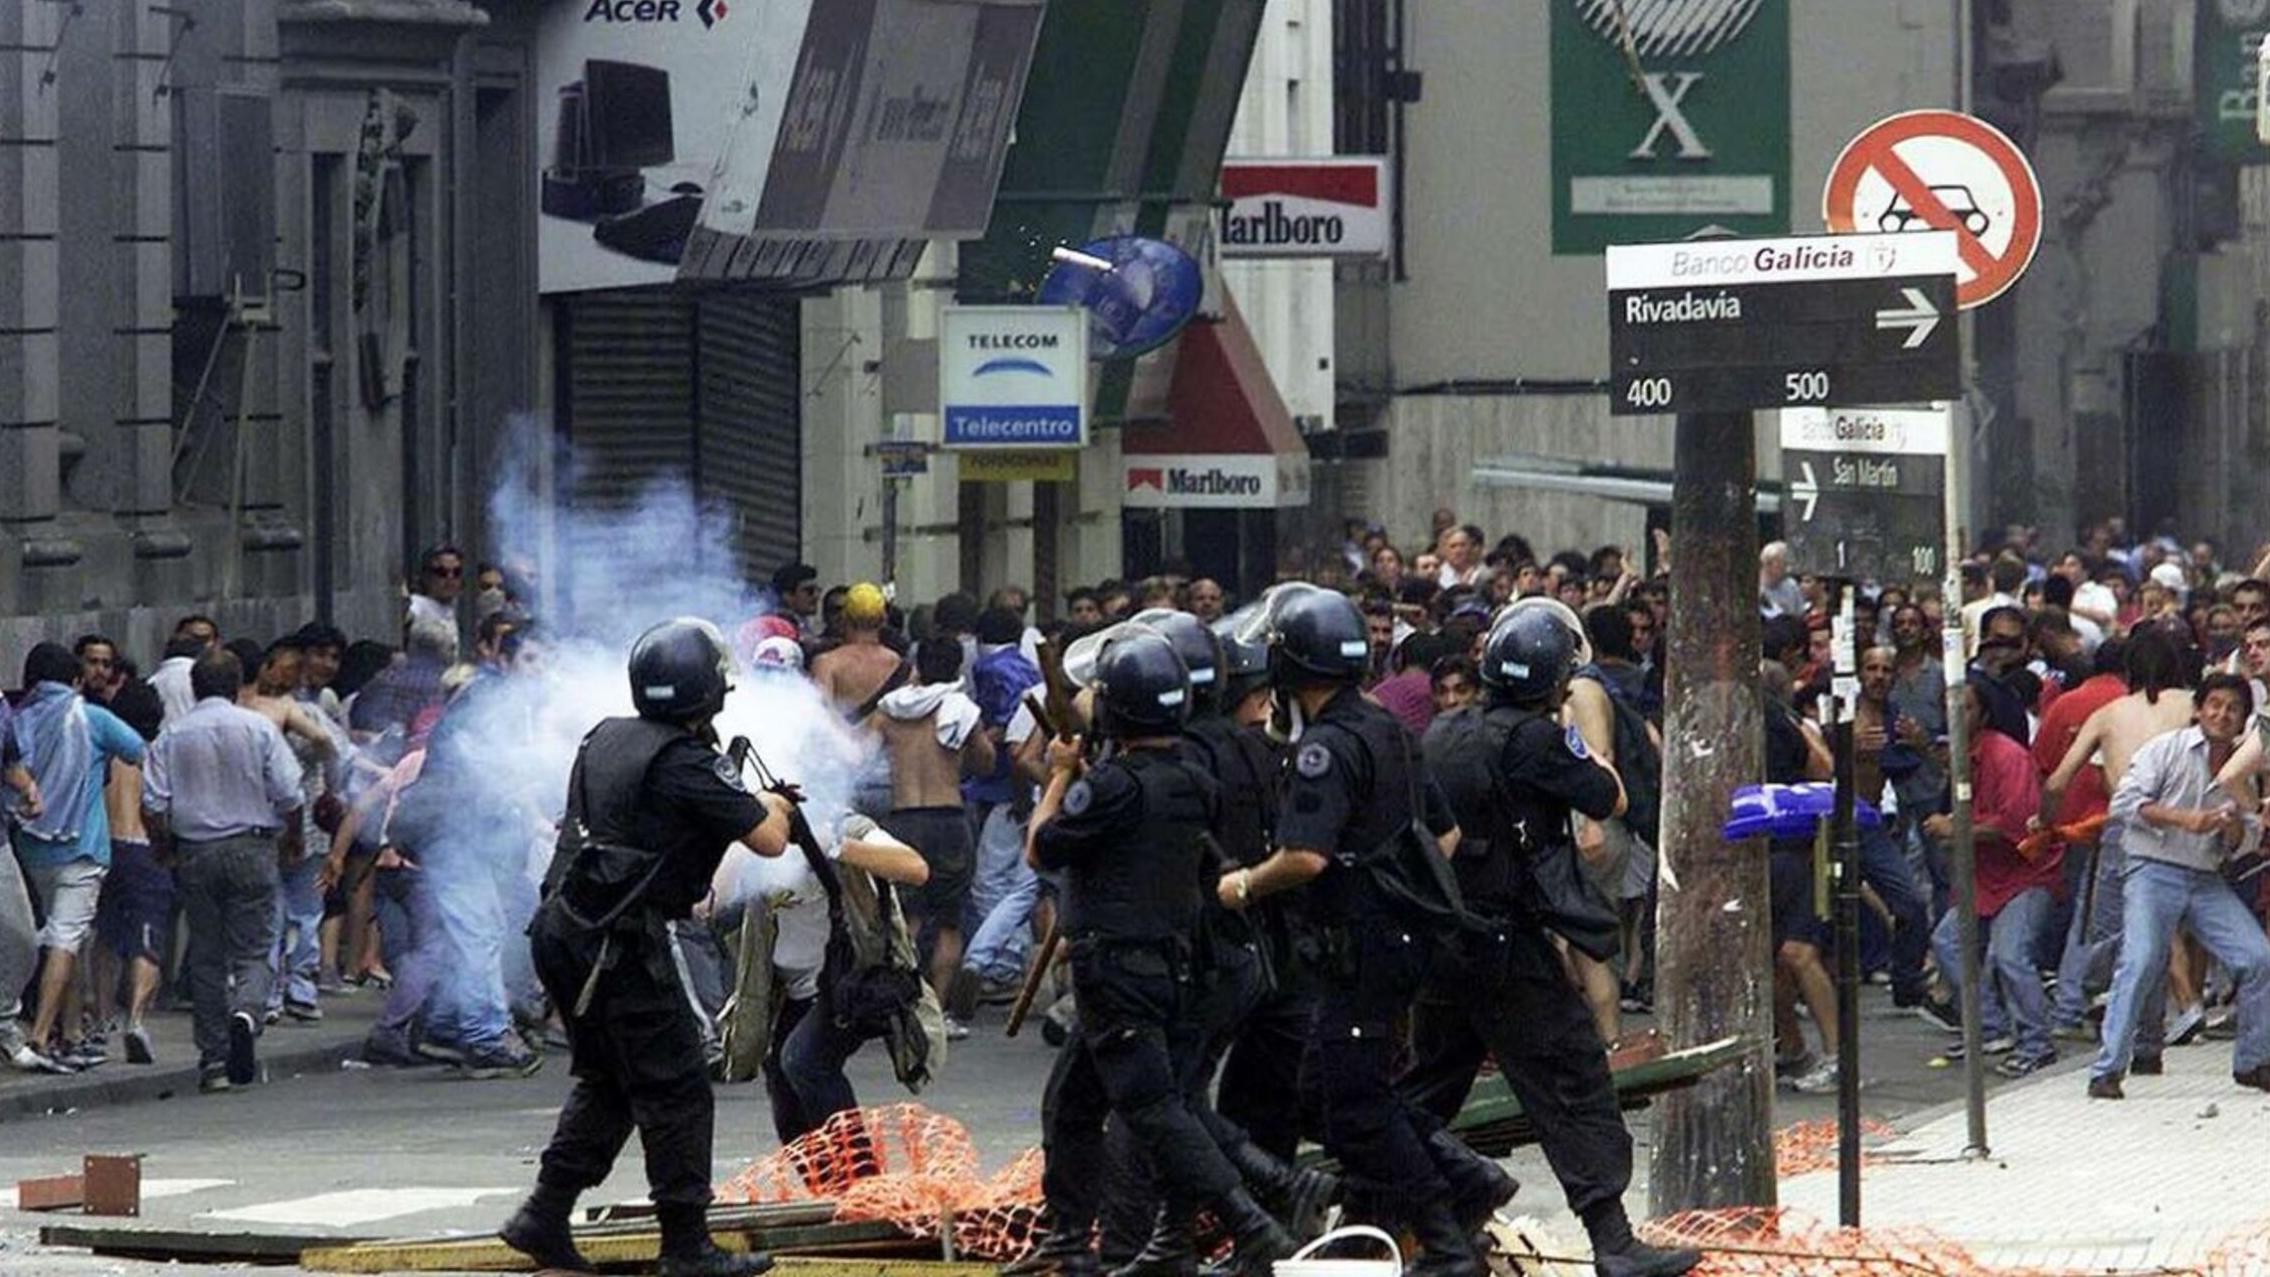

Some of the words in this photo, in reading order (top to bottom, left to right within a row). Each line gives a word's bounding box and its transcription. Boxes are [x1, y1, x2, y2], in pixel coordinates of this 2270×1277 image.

[1629, 72, 1713, 158] X
[1671, 249, 1748, 277] Banco
[1753, 243, 1854, 272] Galicia
[1625, 290, 1742, 324] Rivadavia
[967, 334, 1059, 350] TELECOM
[1626, 377, 1672, 407] 400
[1785, 372, 1829, 401] 500
[953, 417, 1074, 437] Telecentro
[1835, 414, 1886, 441] Galicia
[1167, 467, 1261, 495] Marlboro
[1833, 456, 1856, 485] San
[1912, 546, 1936, 576] 100
